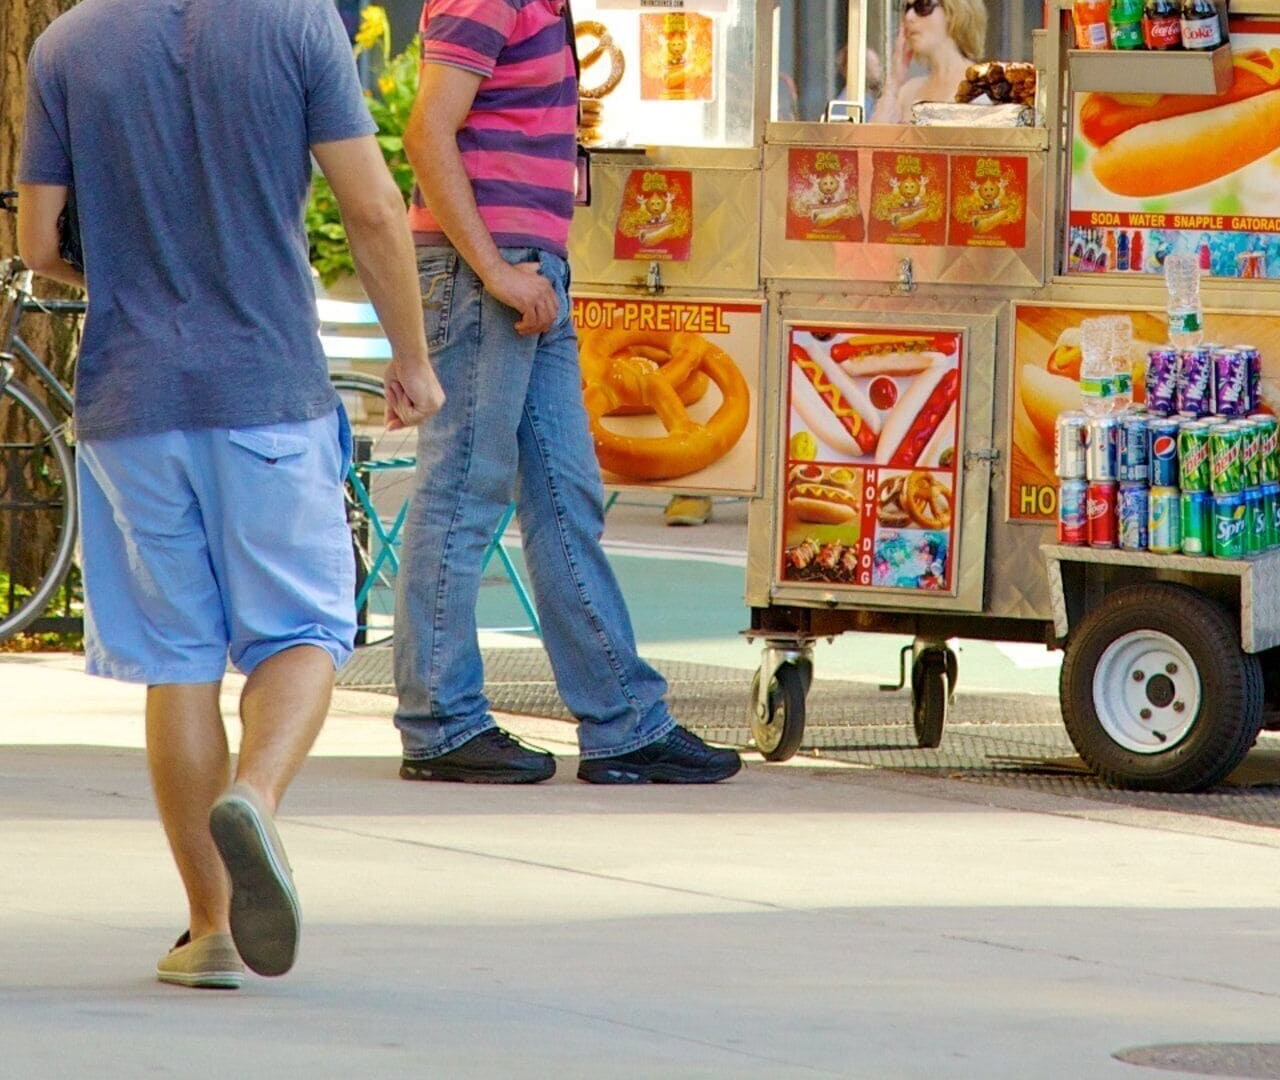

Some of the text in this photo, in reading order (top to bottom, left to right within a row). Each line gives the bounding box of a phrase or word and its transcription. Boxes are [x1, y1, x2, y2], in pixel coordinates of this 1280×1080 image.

[1091, 212, 1120, 226] SODA
[1129, 214, 1166, 227] WATER
[1173, 215, 1224, 229] SNAPPLE
[572, 301, 731, 333] HOT PRETZEL
[1021, 486, 1057, 514] HO
